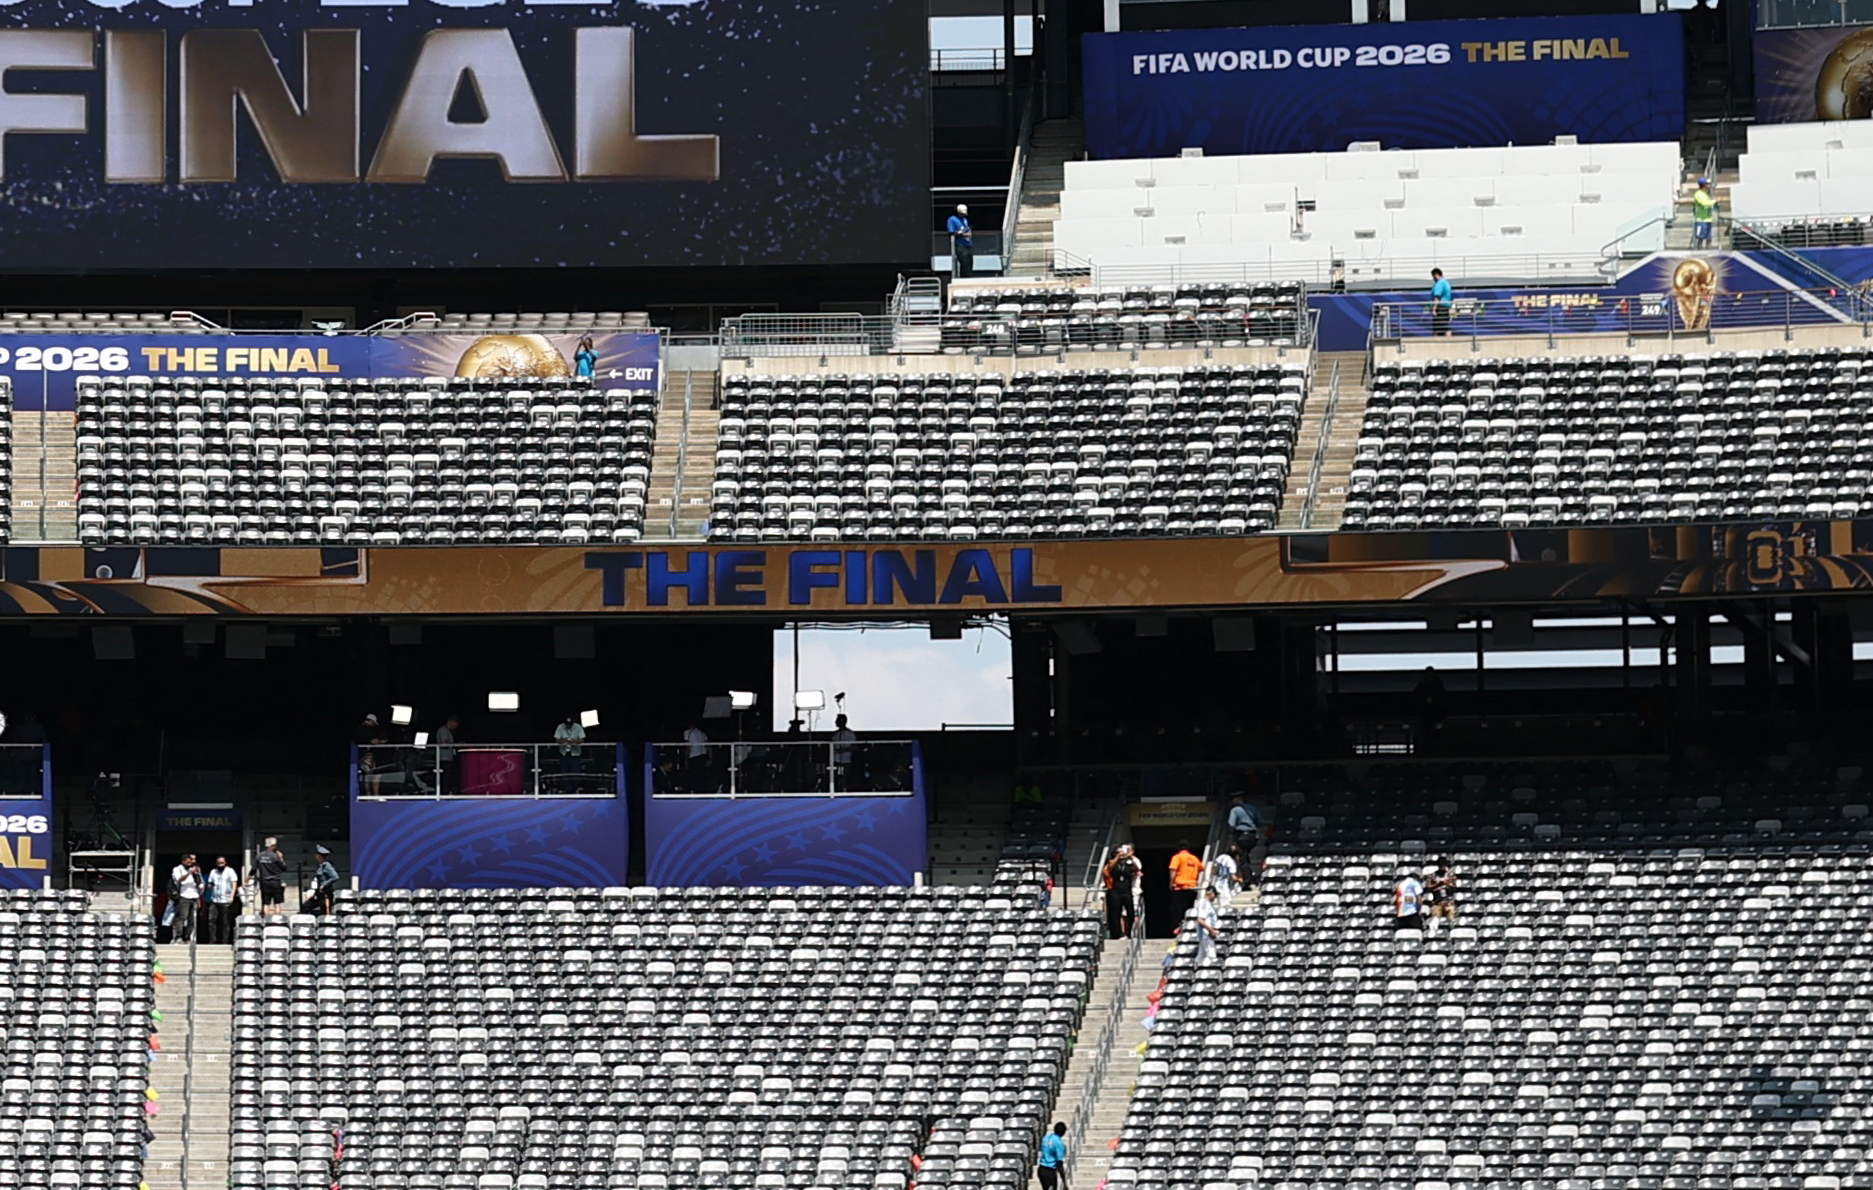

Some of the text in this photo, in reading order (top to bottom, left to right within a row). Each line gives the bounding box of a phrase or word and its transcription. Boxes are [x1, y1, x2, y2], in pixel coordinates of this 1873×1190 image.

[1134, 38, 1629, 75] FIFA WORLD CUP 2026 THE FINAL
[1511, 293, 1604, 308] THE FINAL
[1641, 304, 1661, 316] 249
[986, 324, 1004, 335] 248
[14, 347, 130, 372] 2026
[141, 347, 219, 372] THE
[226, 347, 340, 373] FINAL
[625, 368, 653, 381] EXIT
[584, 548, 1062, 606] THE FINAL
[166, 817, 233, 827] THE FINAL
